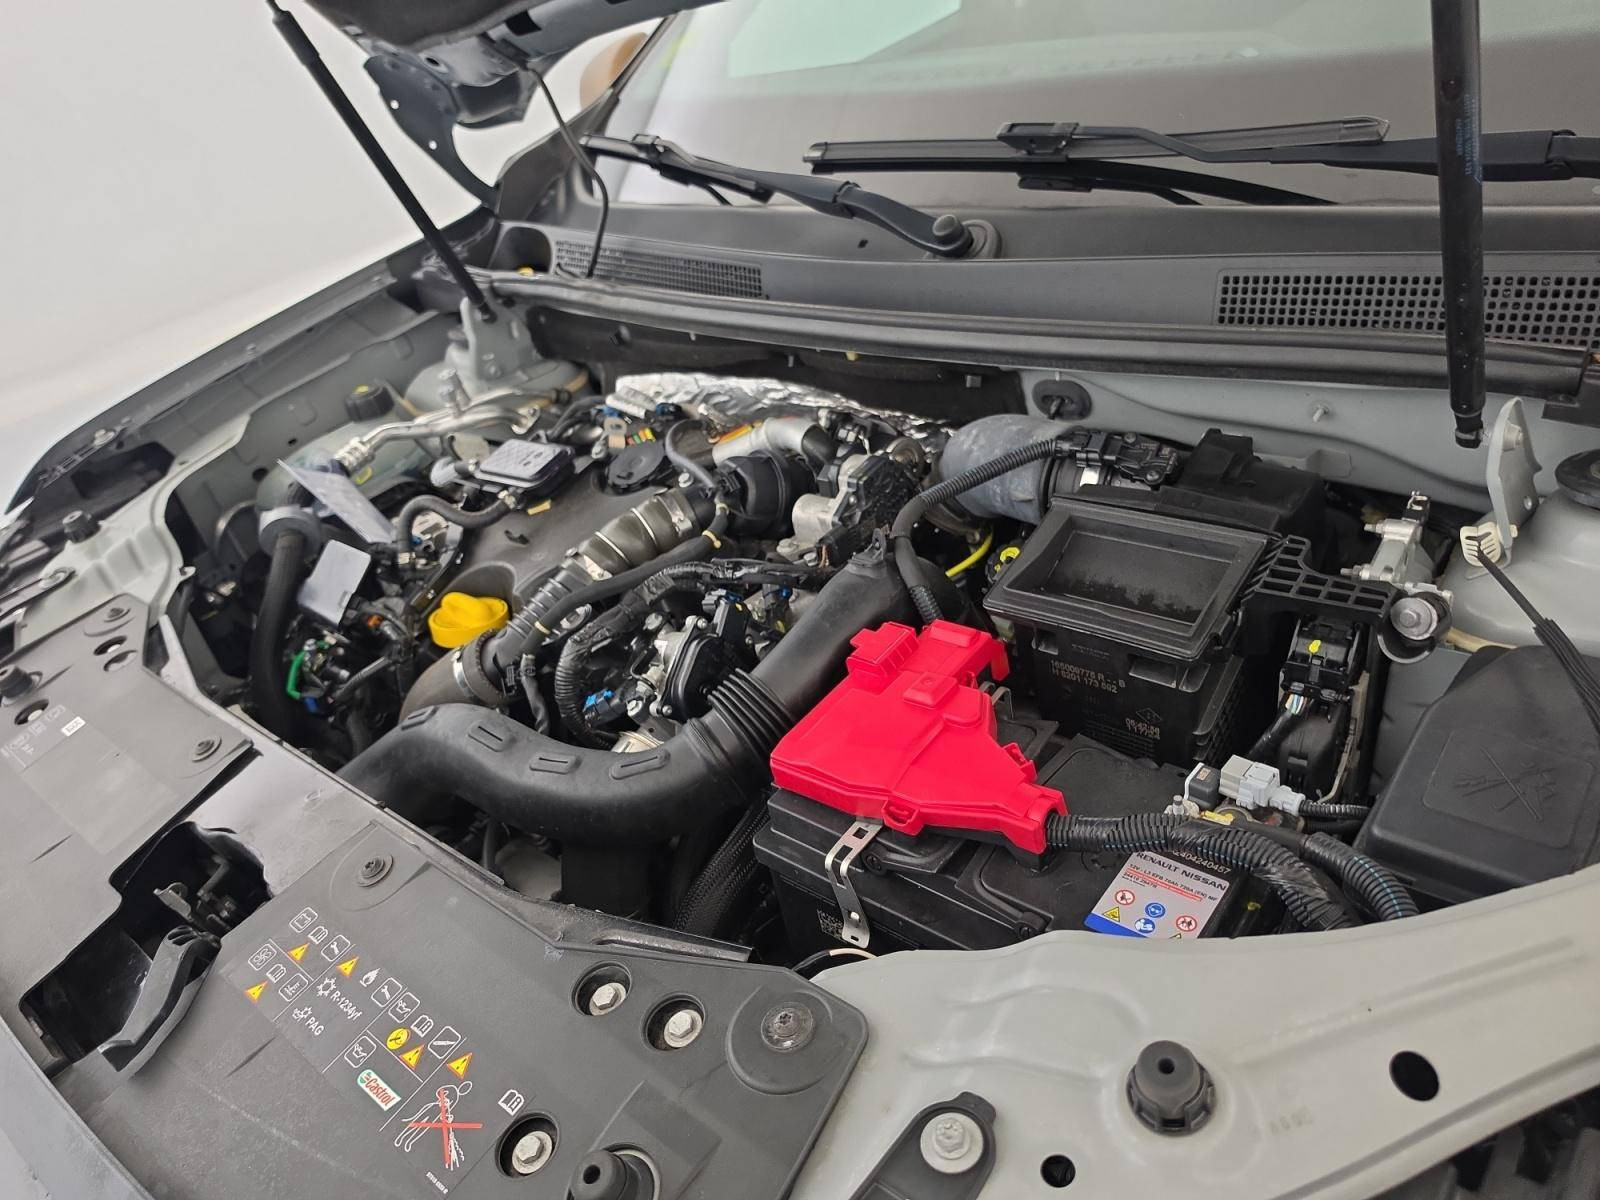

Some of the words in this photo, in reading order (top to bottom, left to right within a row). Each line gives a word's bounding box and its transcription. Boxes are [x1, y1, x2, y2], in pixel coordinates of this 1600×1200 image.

[1136, 852, 1179, 872] RENAULT
[1181, 870, 1227, 891] NISSAN
[1151, 872, 1164, 881] EFB
[330, 990, 363, 1022] R-1234yf
[305, 1016, 325, 1037] PAG
[364, 1077, 397, 1107] Castrol
